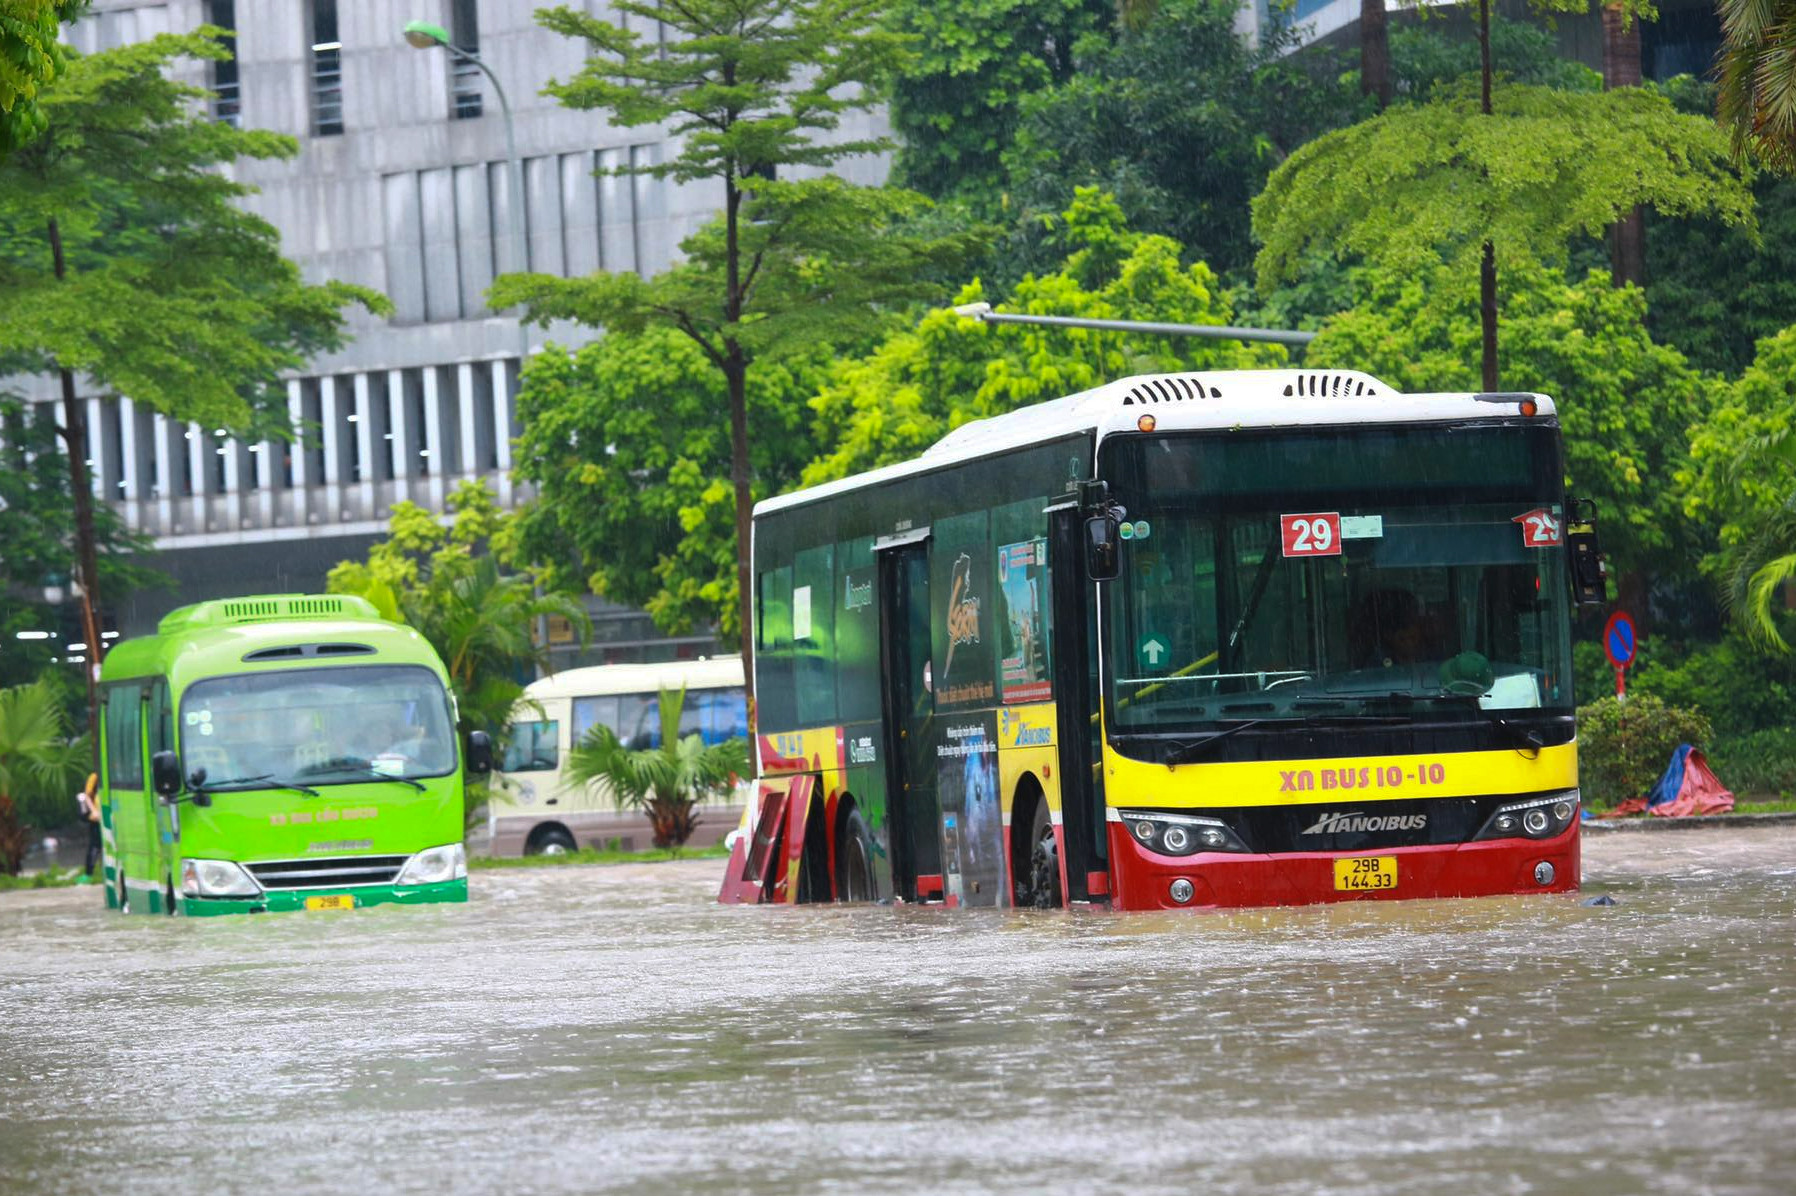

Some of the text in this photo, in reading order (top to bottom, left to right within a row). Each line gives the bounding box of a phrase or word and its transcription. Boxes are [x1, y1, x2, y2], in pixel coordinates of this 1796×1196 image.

[1291, 518, 1332, 551] 29
[1279, 769, 1315, 792] XN
[1321, 767, 1369, 790] BUS
[1301, 811, 1427, 835] HANOIBUS
[1352, 858, 1380, 873] 29B
[1342, 873, 1392, 889] 144.33
